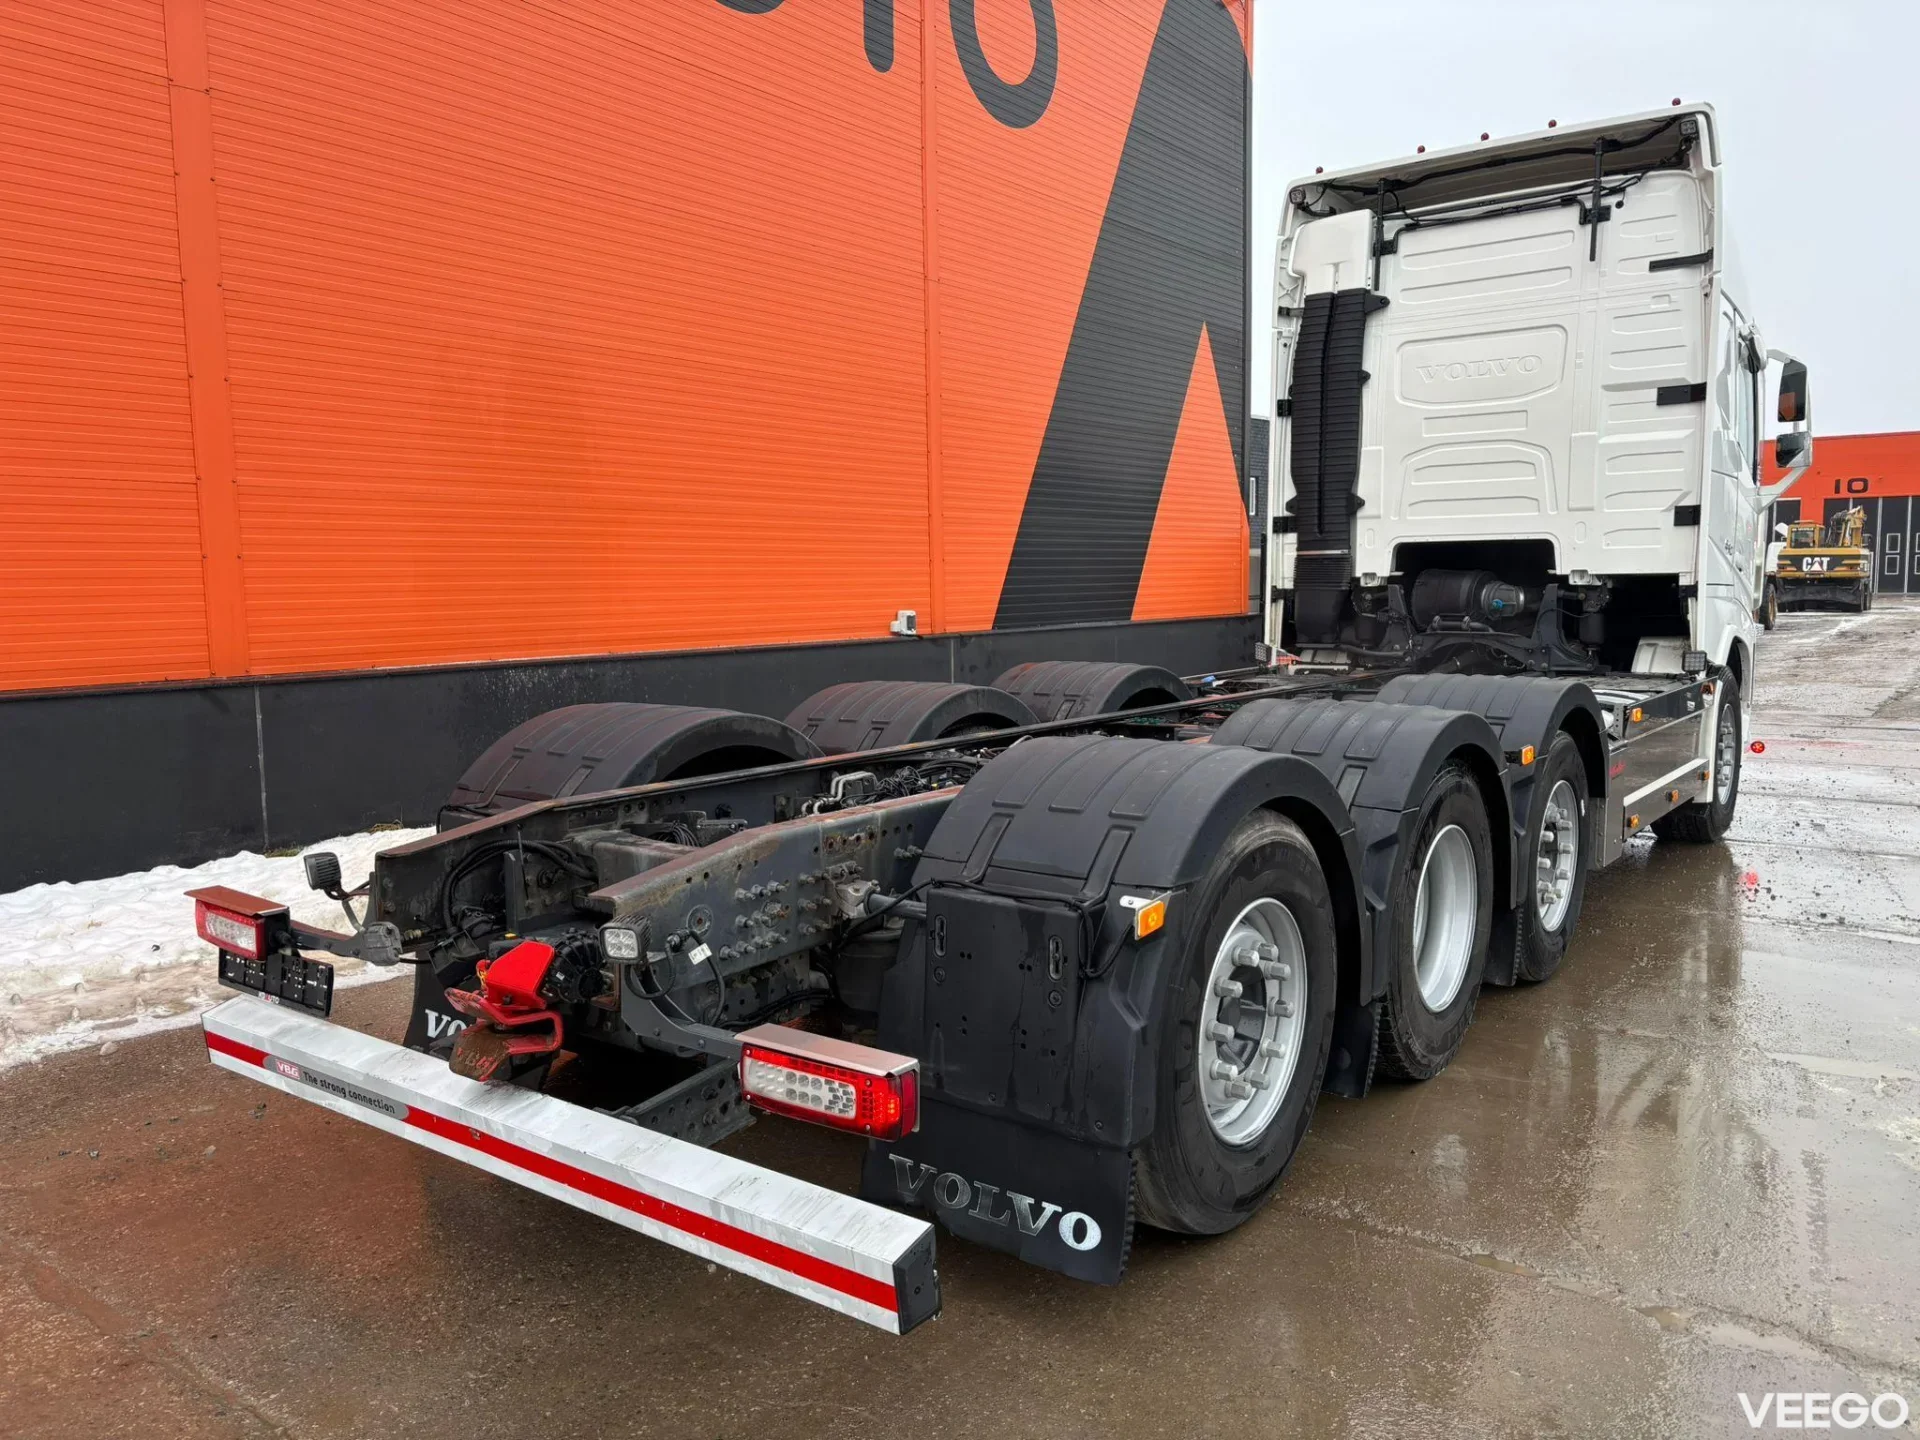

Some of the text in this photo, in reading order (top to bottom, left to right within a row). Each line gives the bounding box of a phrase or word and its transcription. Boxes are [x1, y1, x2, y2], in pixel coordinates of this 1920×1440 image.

[1415, 355, 1543, 384] VOLVO
[1802, 556, 1831, 572] CAT
[277, 1061, 396, 1114] VBG The strong connection
[889, 1153, 1102, 1251] VOLVO
